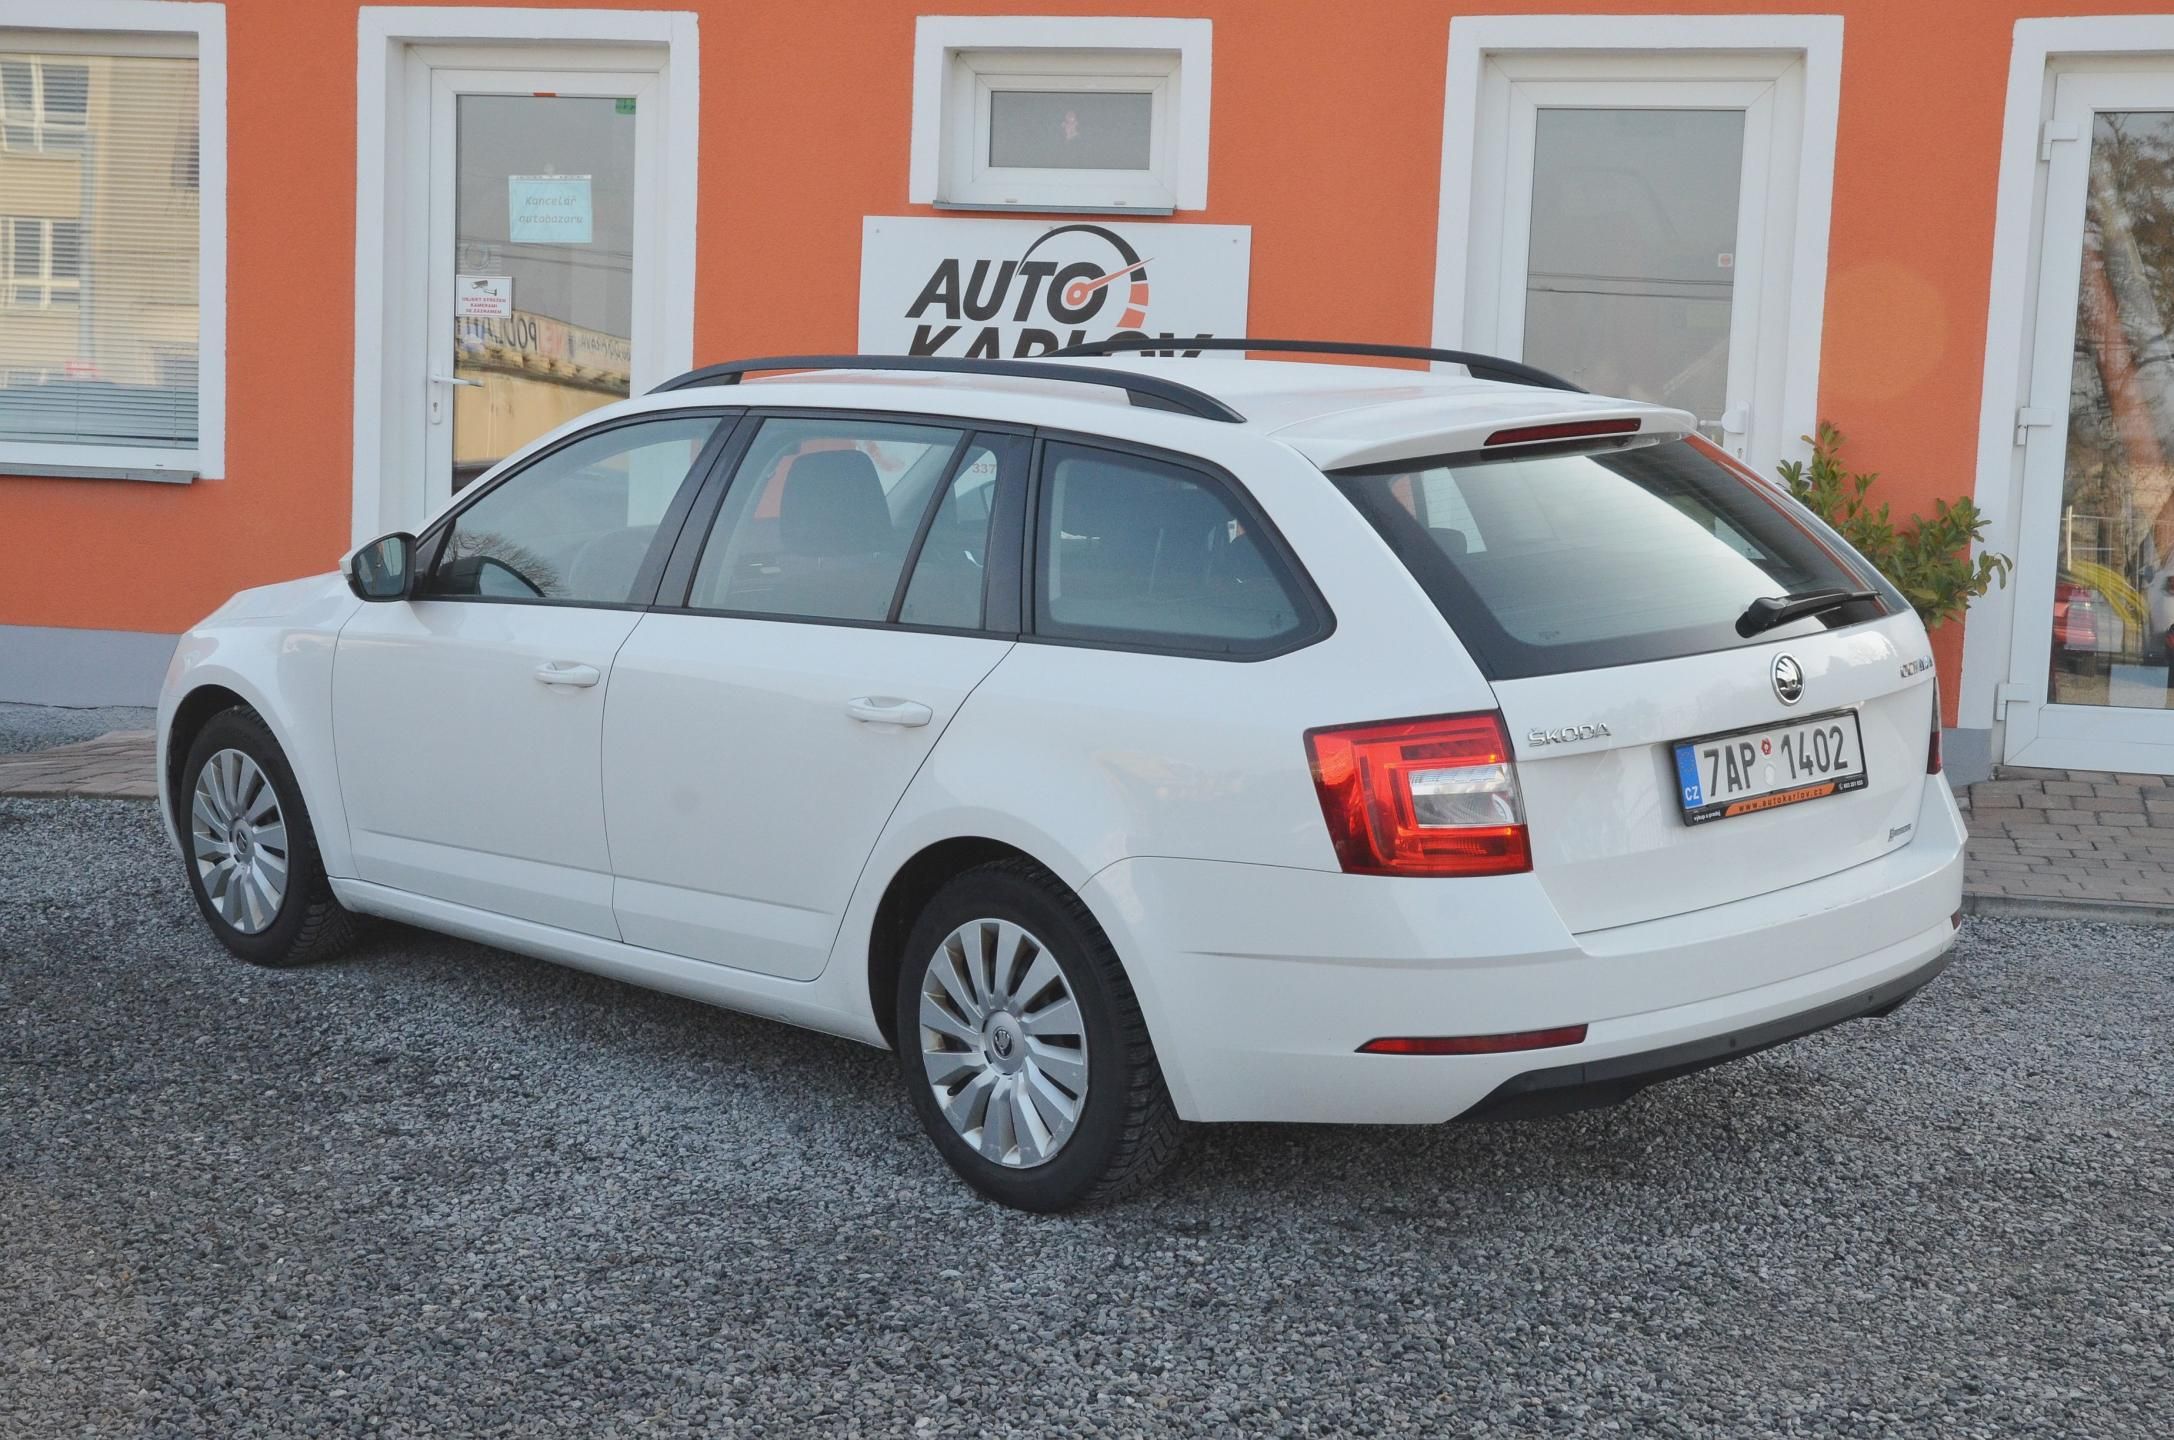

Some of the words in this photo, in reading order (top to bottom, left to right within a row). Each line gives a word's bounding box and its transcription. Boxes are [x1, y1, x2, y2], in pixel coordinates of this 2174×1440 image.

[904, 258, 1110, 325] AUTO
[1527, 722, 1611, 747] ŠKODA
[1704, 742, 1755, 797] 7AP
[1780, 726, 1848, 780] 1402
[1685, 786, 1700, 801] CZ
[1738, 788, 1823, 812] www.autokarlov.cz
